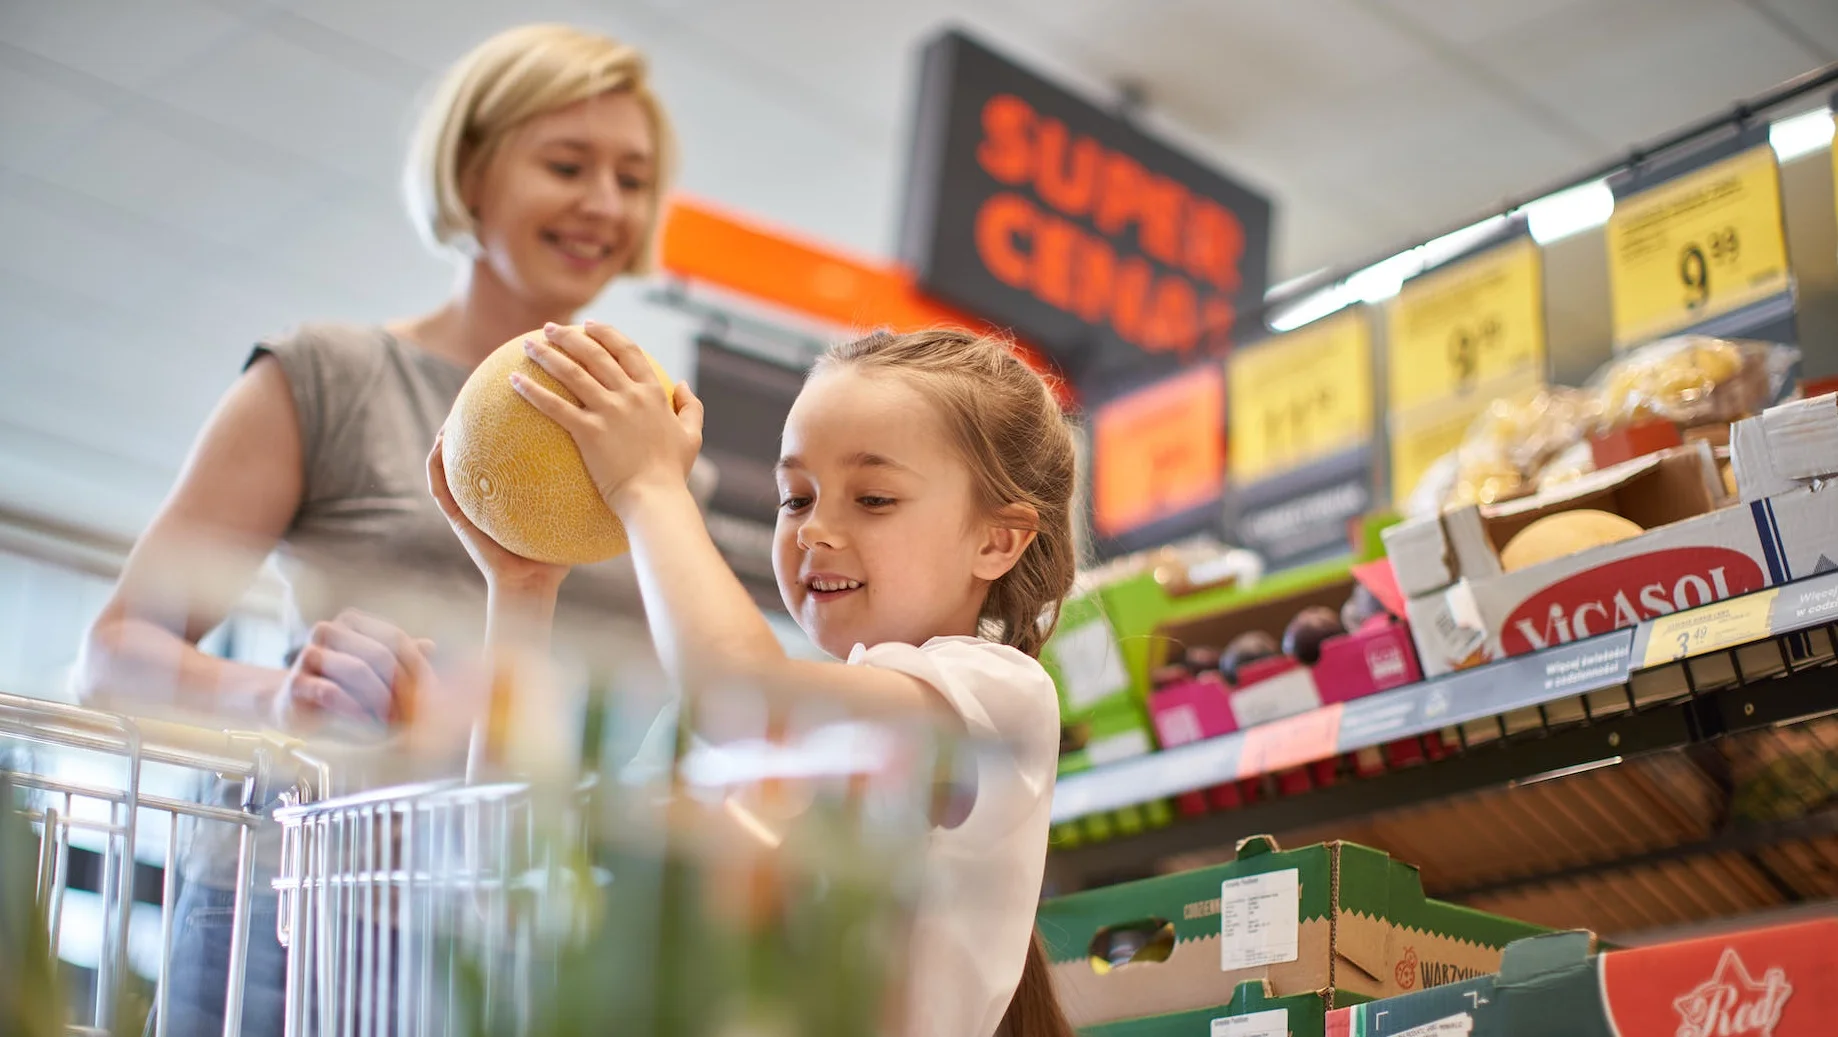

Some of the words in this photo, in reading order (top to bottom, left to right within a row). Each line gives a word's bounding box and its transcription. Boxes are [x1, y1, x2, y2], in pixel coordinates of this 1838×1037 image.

[976, 93, 1246, 293] SUPER
[1680, 241, 1709, 310] 9
[1673, 632, 1690, 661] 3
